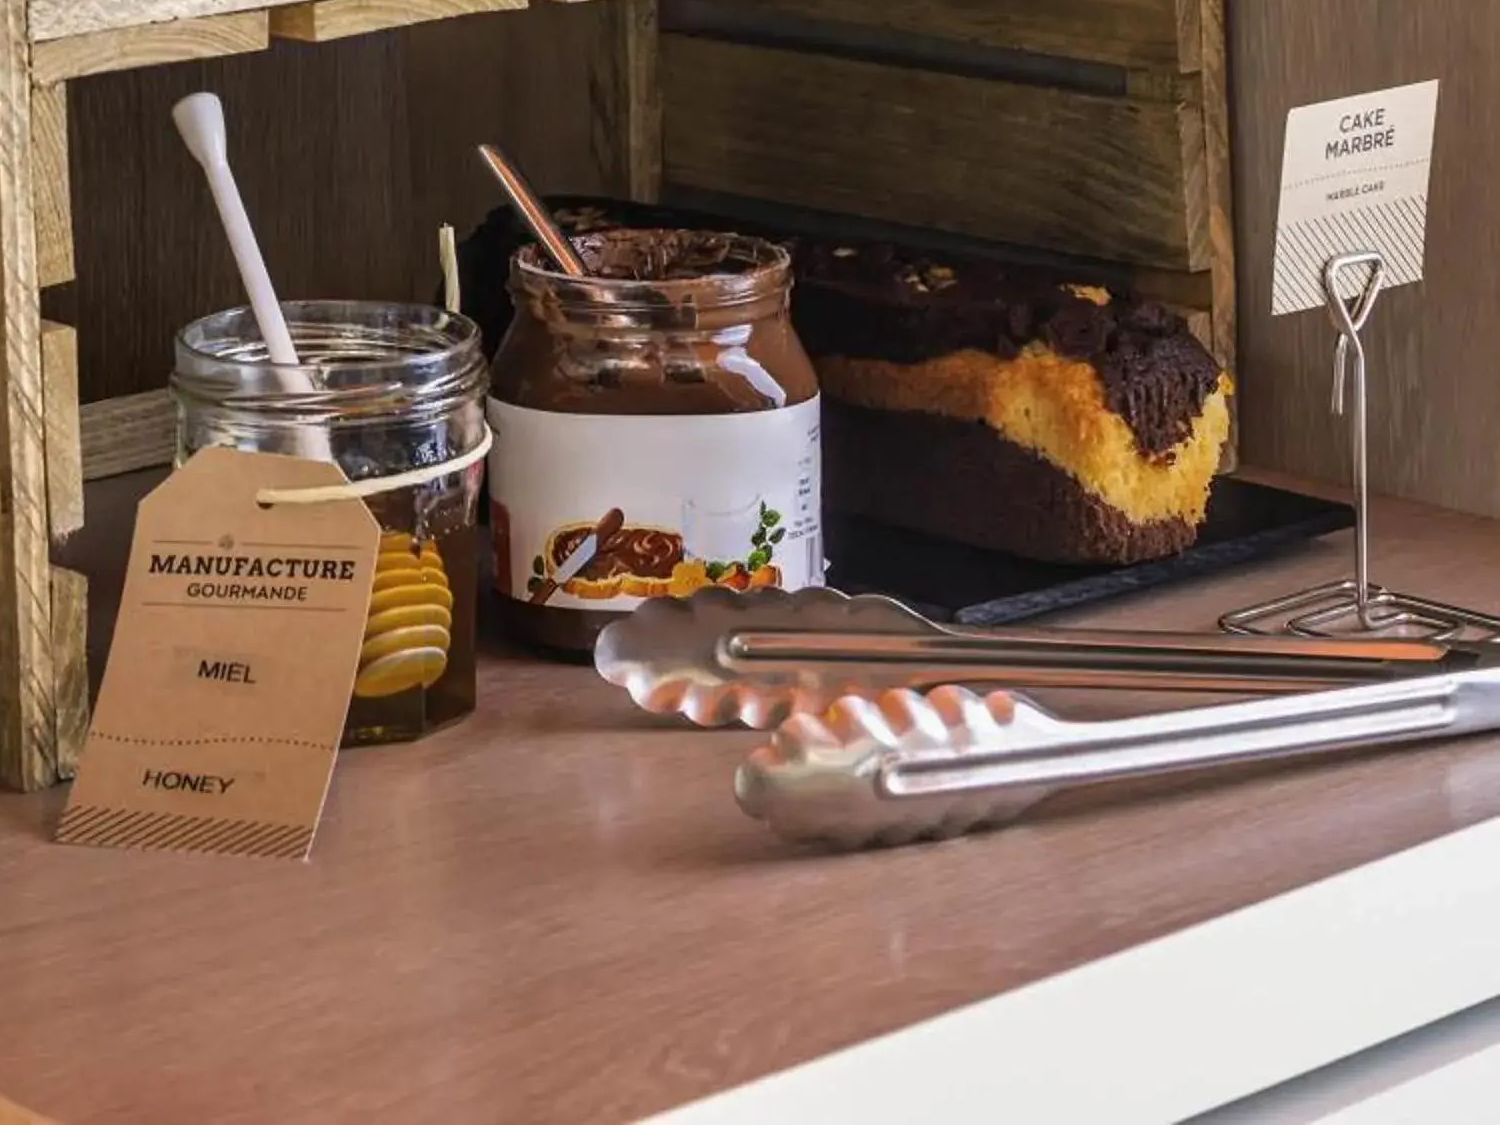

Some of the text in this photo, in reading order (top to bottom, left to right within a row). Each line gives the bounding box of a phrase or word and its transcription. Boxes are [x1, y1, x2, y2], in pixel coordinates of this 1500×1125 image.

[1339, 108, 1386, 133] CAKE
[1325, 125, 1395, 160] MARBRÉ
[149, 555, 357, 581] MANUFACTURE
[187, 584, 309, 602] GOURMANDE
[198, 660, 257, 685] MIEL
[142, 769, 235, 795] HONEY
